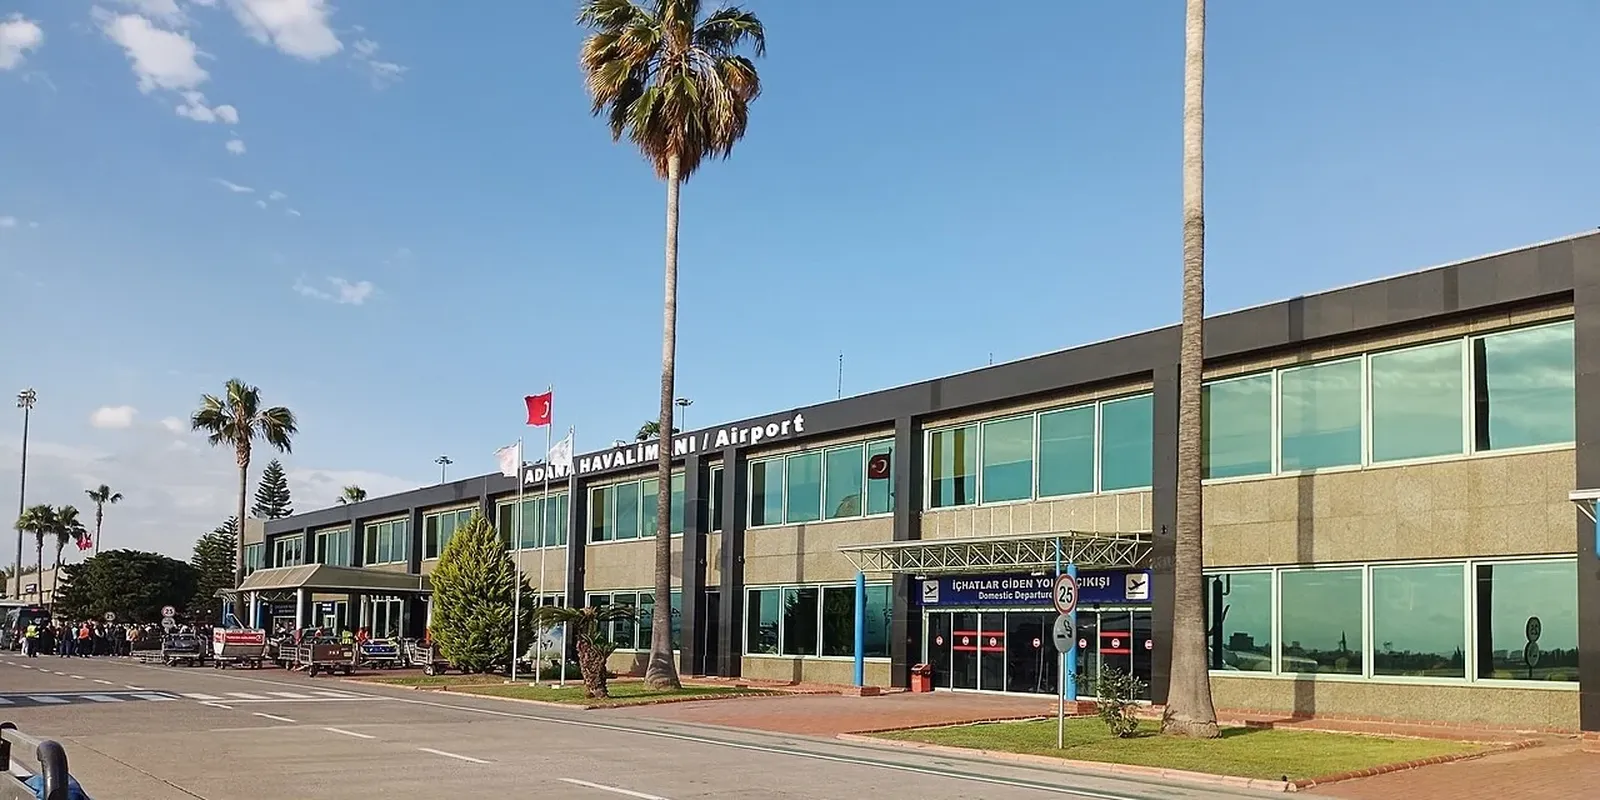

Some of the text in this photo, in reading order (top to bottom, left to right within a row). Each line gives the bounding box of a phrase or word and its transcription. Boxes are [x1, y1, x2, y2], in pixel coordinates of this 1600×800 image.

[524, 413, 806, 485] ADANA HAVALİMNI / Airport
[952, 579, 999, 592] İÇHATLAR
[1001, 577, 1033, 589] GİDEN
[978, 591, 1013, 600] Domestic
[1058, 586, 1073, 604] 25
